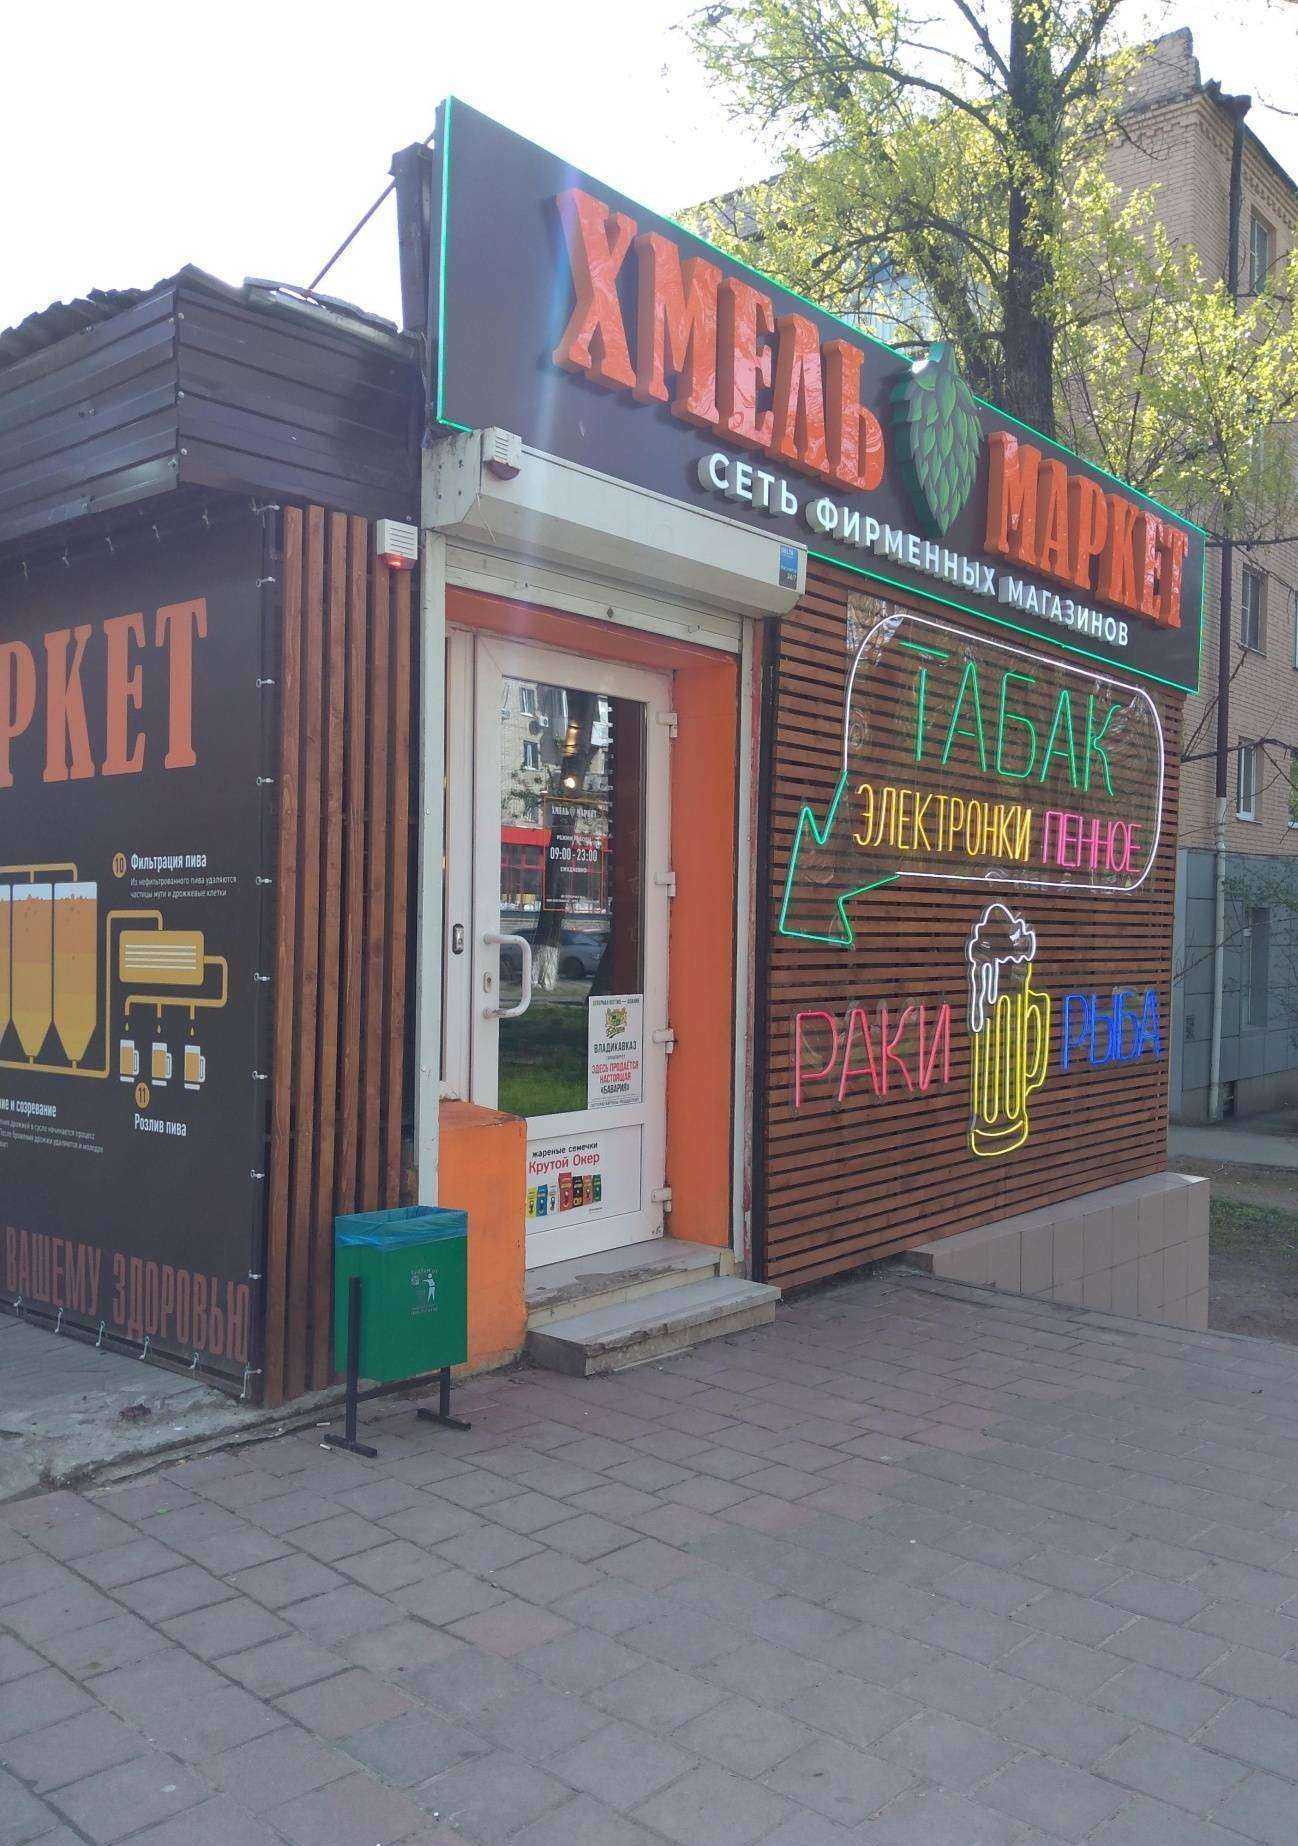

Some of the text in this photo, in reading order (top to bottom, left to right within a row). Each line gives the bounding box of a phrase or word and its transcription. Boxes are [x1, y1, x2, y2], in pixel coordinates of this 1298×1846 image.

[553, 187, 885, 492] ХМЕЛЬ
[701, 452, 1129, 646] СЕТЬ ФИРМЕННЫХ МАГАЗИНОВ
[984, 430, 1188, 629] МАРКЕТ
[899, 640, 1121, 796] ТАБАК
[130, 852, 183, 872] Фильтрация
[185, 854, 207, 868] пива
[852, 783, 1142, 874] ЭЛЕКТРОНКИ ПЕННОЕ
[191, 876, 205, 884] пива
[593, 1041, 637, 1054] ВЛАДИКАВКАЗ
[794, 1001, 952, 1107] РАКИ
[1062, 990, 1163, 1070] РЫБА
[10, 1099, 15, 1111] и
[16, 1100, 57, 1117] созревание
[134, 1113, 187, 1136] Розлив пива
[528, 1153, 600, 1175] Крутой Окер
[532, 1142, 598, 1159] жареные семечки
[6, 1225, 250, 1365] ВАШЕМУ ЗДОРОВЬЮ
